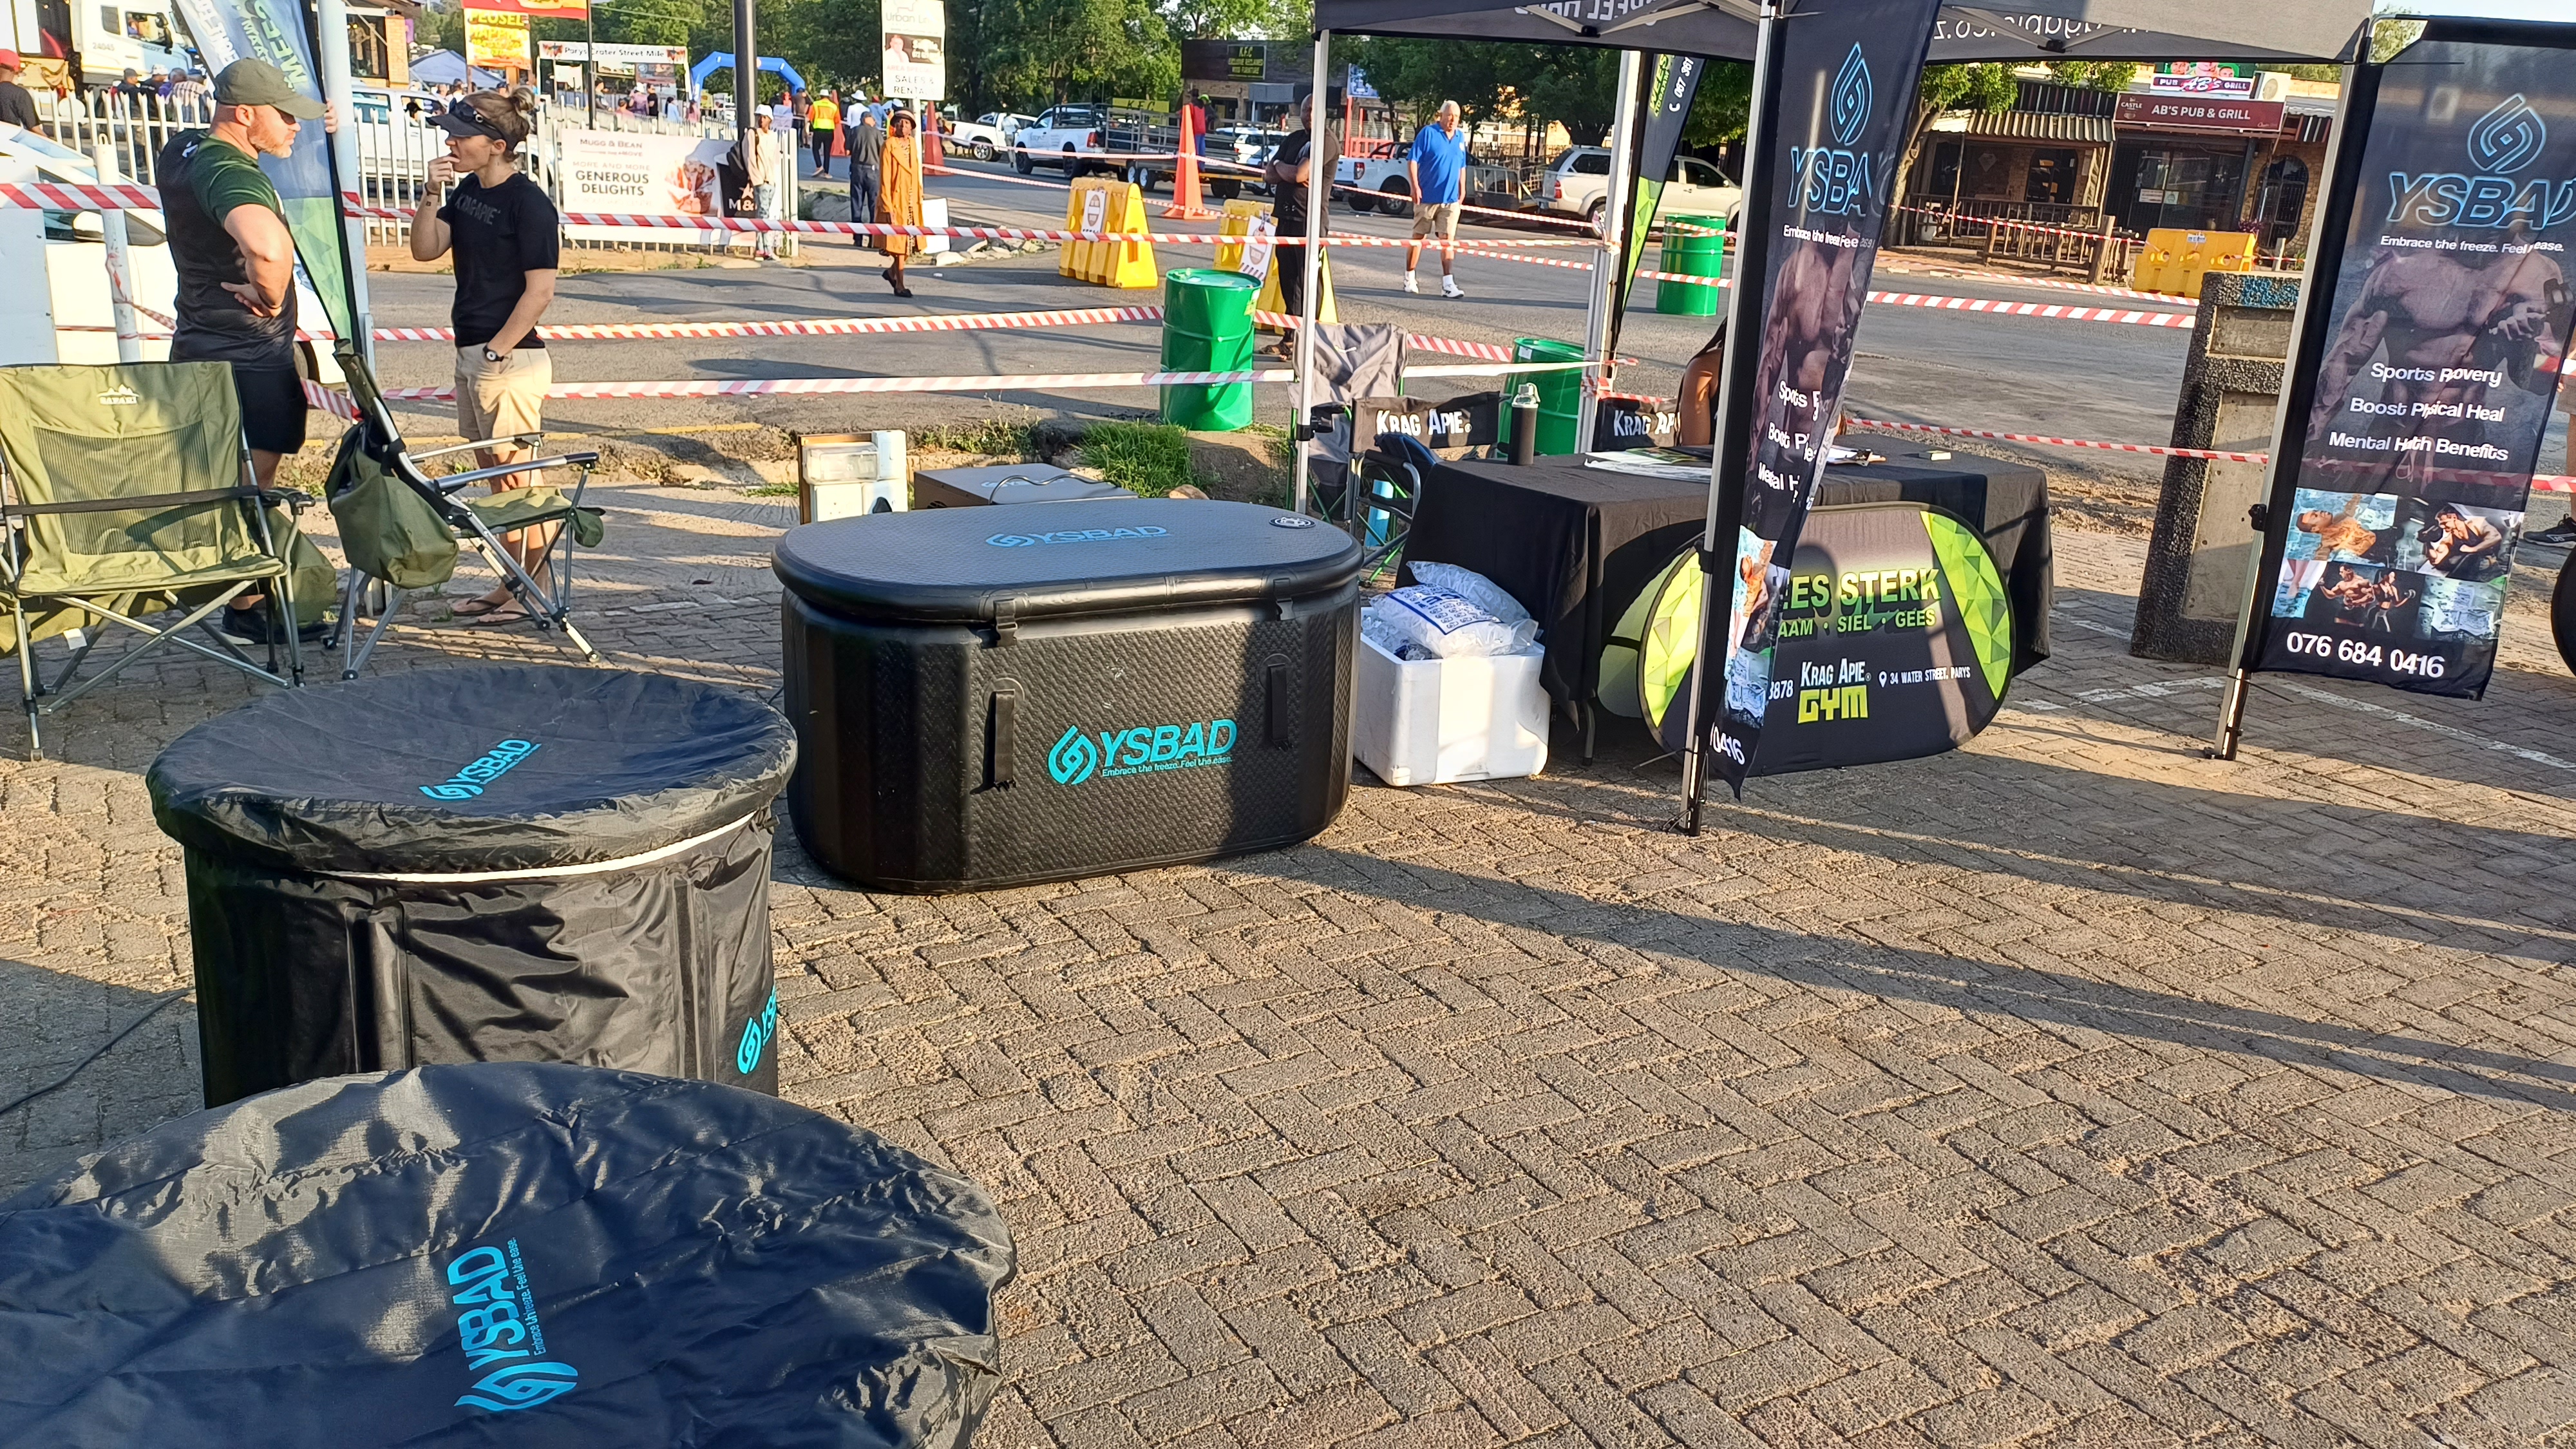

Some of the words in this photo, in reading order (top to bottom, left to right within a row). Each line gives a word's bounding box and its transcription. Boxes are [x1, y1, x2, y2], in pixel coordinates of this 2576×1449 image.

[886, 12, 915, 23] Urban
[565, 46, 587, 59] Parys
[895, 75, 925, 84] SALES
[1649, 53, 1667, 109] WEES
[2121, 101, 2143, 109] CASTLE
[2152, 105, 2179, 116] AB'S
[2181, 107, 2205, 118] PUB
[2207, 108, 2215, 118] &
[2218, 109, 2251, 120] GRILL
[625, 163, 651, 171] MORE
[575, 170, 649, 184] GENEROUS
[582, 183, 644, 197] DELIGHTS
[729, 198, 757, 211] M&
[2380, 235, 2432, 249] Embrace
[2435, 239, 2457, 251] the
[2459, 241, 2499, 252] freeze.
[2502, 243, 2527, 254] Feel
[2533, 242, 2564, 252] ease.
[2371, 363, 2436, 383] Sports
[2350, 397, 2407, 416] Boost
[1376, 410, 1422, 437] KRAG
[1428, 408, 1464, 435] APIE
[1614, 410, 1652, 436] KRAG
[2329, 431, 2391, 450] Mental
[2435, 438, 2509, 462] Benefits
[1028, 526, 1167, 544] YSBAD
[1783, 574, 1830, 610] ES
[1840, 568, 1942, 606] STERK
[1837, 614, 1873, 633] SIEL
[1895, 608, 1937, 628] GEES
[2287, 632, 2333, 658] 076
[2338, 639, 2383, 667] 684
[2390, 649, 2446, 679] 0416
[1800, 661, 1834, 688] KRAG
[1838, 658, 1866, 685] APIE
[1889, 672, 1899, 685] 34
[1901, 670, 1923, 685] WATER
[1950, 666, 1971, 679] PARYS
[1798, 684, 1869, 724] GYM
[1099, 718, 1238, 768] YSBAD
[446, 739, 531, 784] YSBAD
[1102, 767, 1137, 777] Embrace
[1139, 764, 1152, 774] the
[1180, 759, 1197, 769] Feel
[1198, 757, 1212, 766] the
[511, 1258, 524, 1273] the
[513, 1273, 529, 1291] Feel
[446, 1245, 531, 1371] YSBAD
[529, 1324, 547, 1357] Embrace
